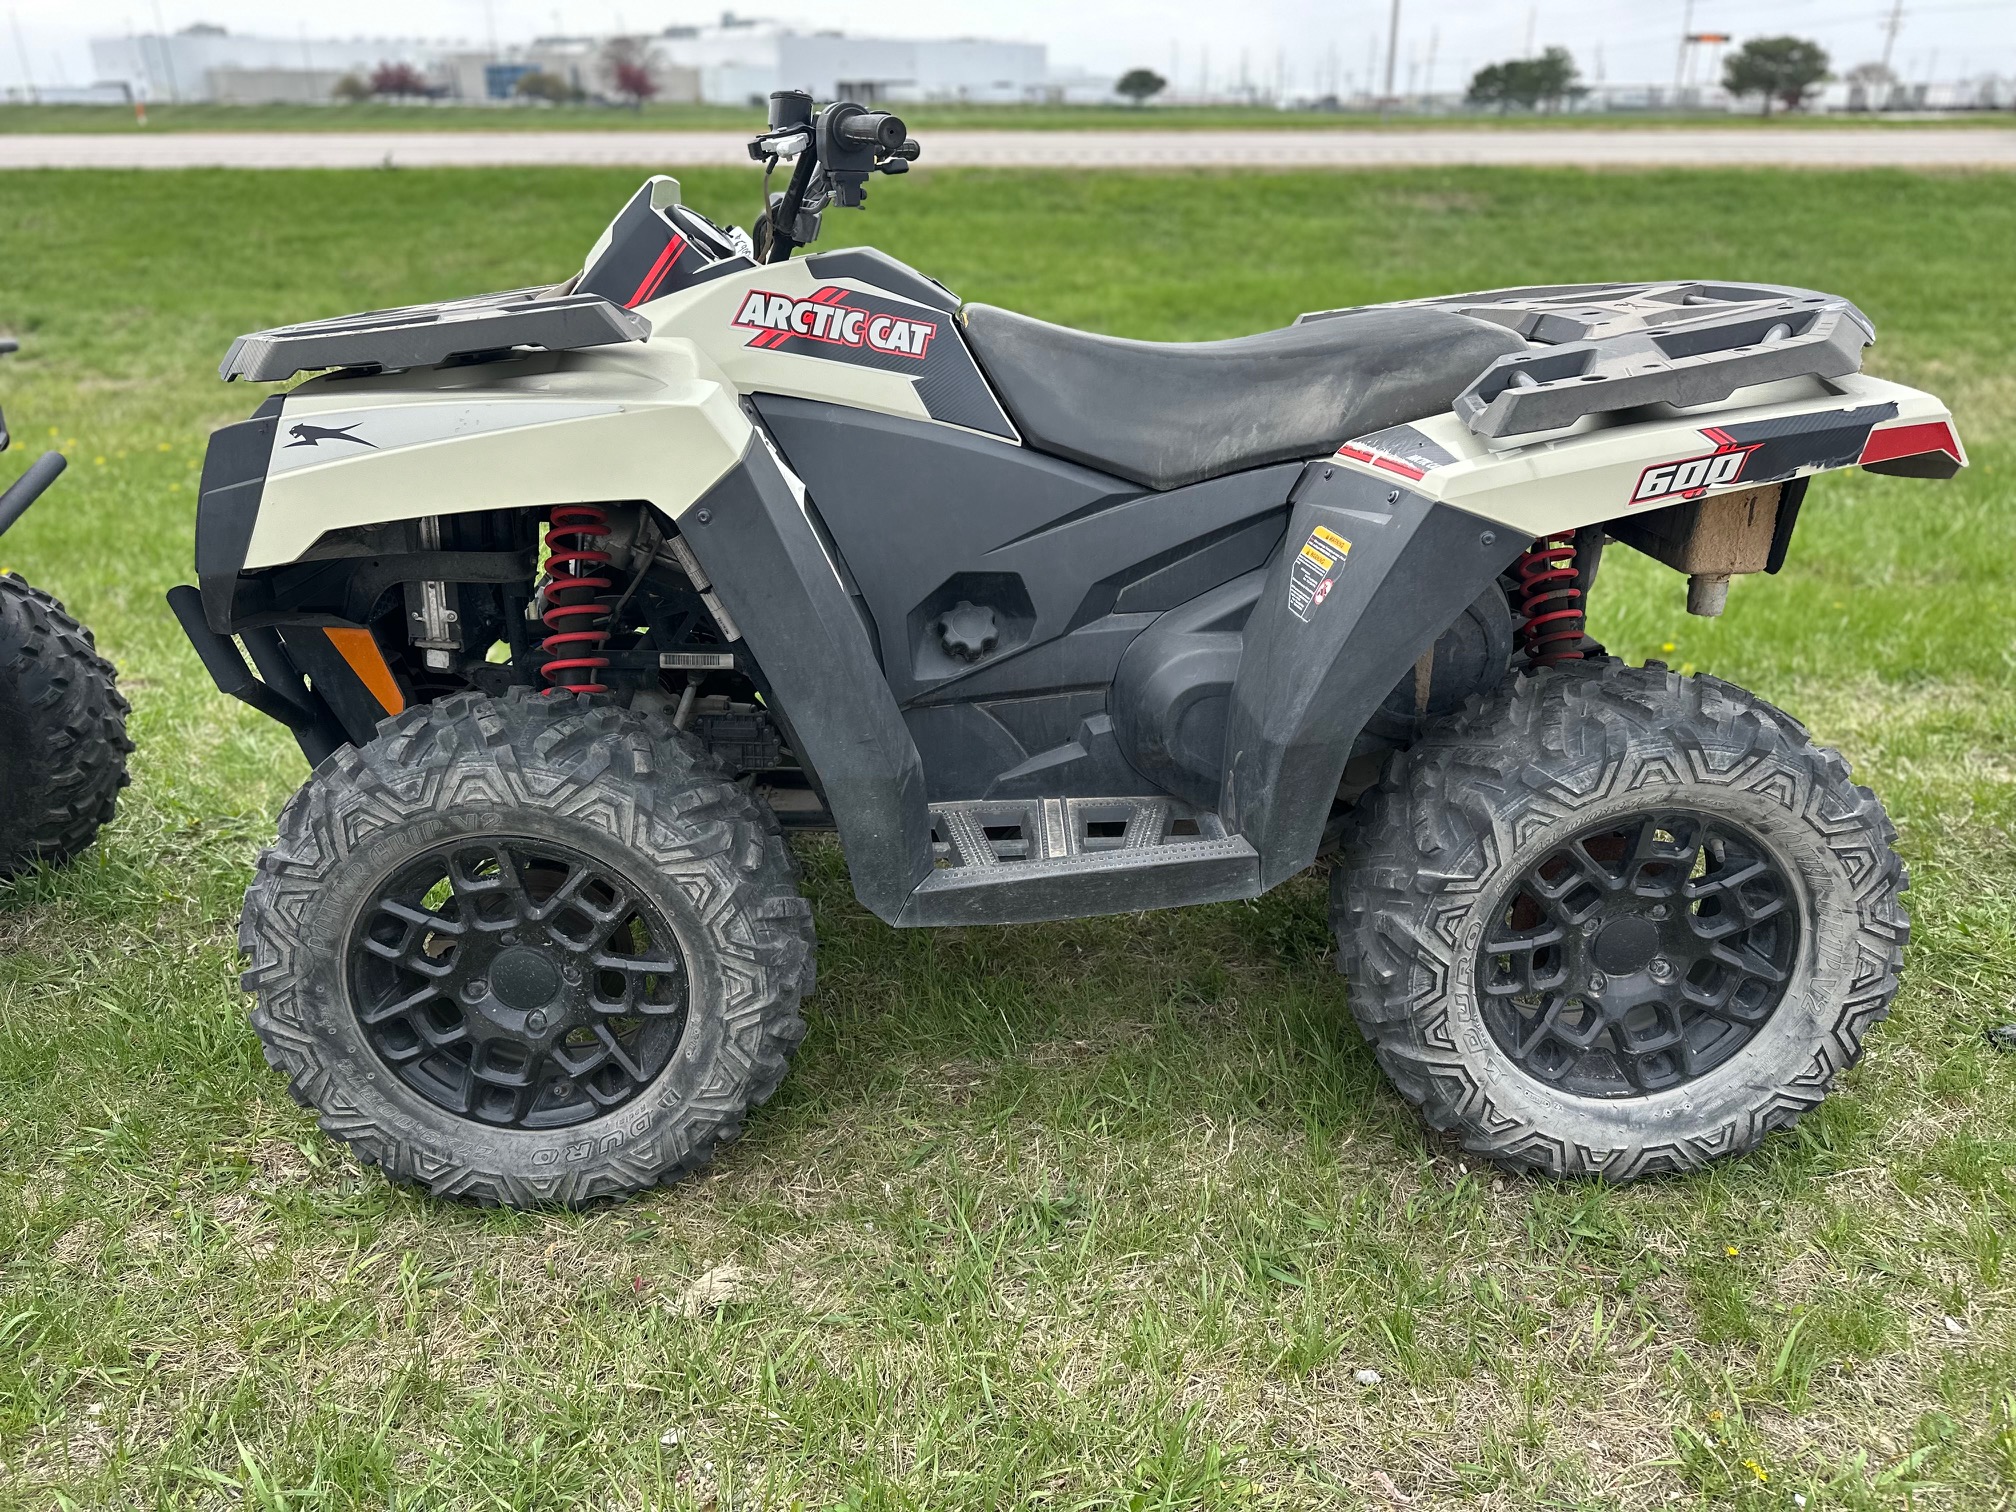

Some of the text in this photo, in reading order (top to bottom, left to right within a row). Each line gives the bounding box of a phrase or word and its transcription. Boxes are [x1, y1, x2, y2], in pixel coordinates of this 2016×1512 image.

[737, 293, 932, 355] ARCTIC CAT
[1635, 451, 1746, 500] 600
[370, 819, 444, 868] GRIP
[450, 812, 503, 832] V2
[1814, 901, 1844, 972] GRIP
[1454, 921, 1482, 1054] DURO
[1801, 977, 1838, 1017] V2
[531, 1110, 652, 1166] DURO
